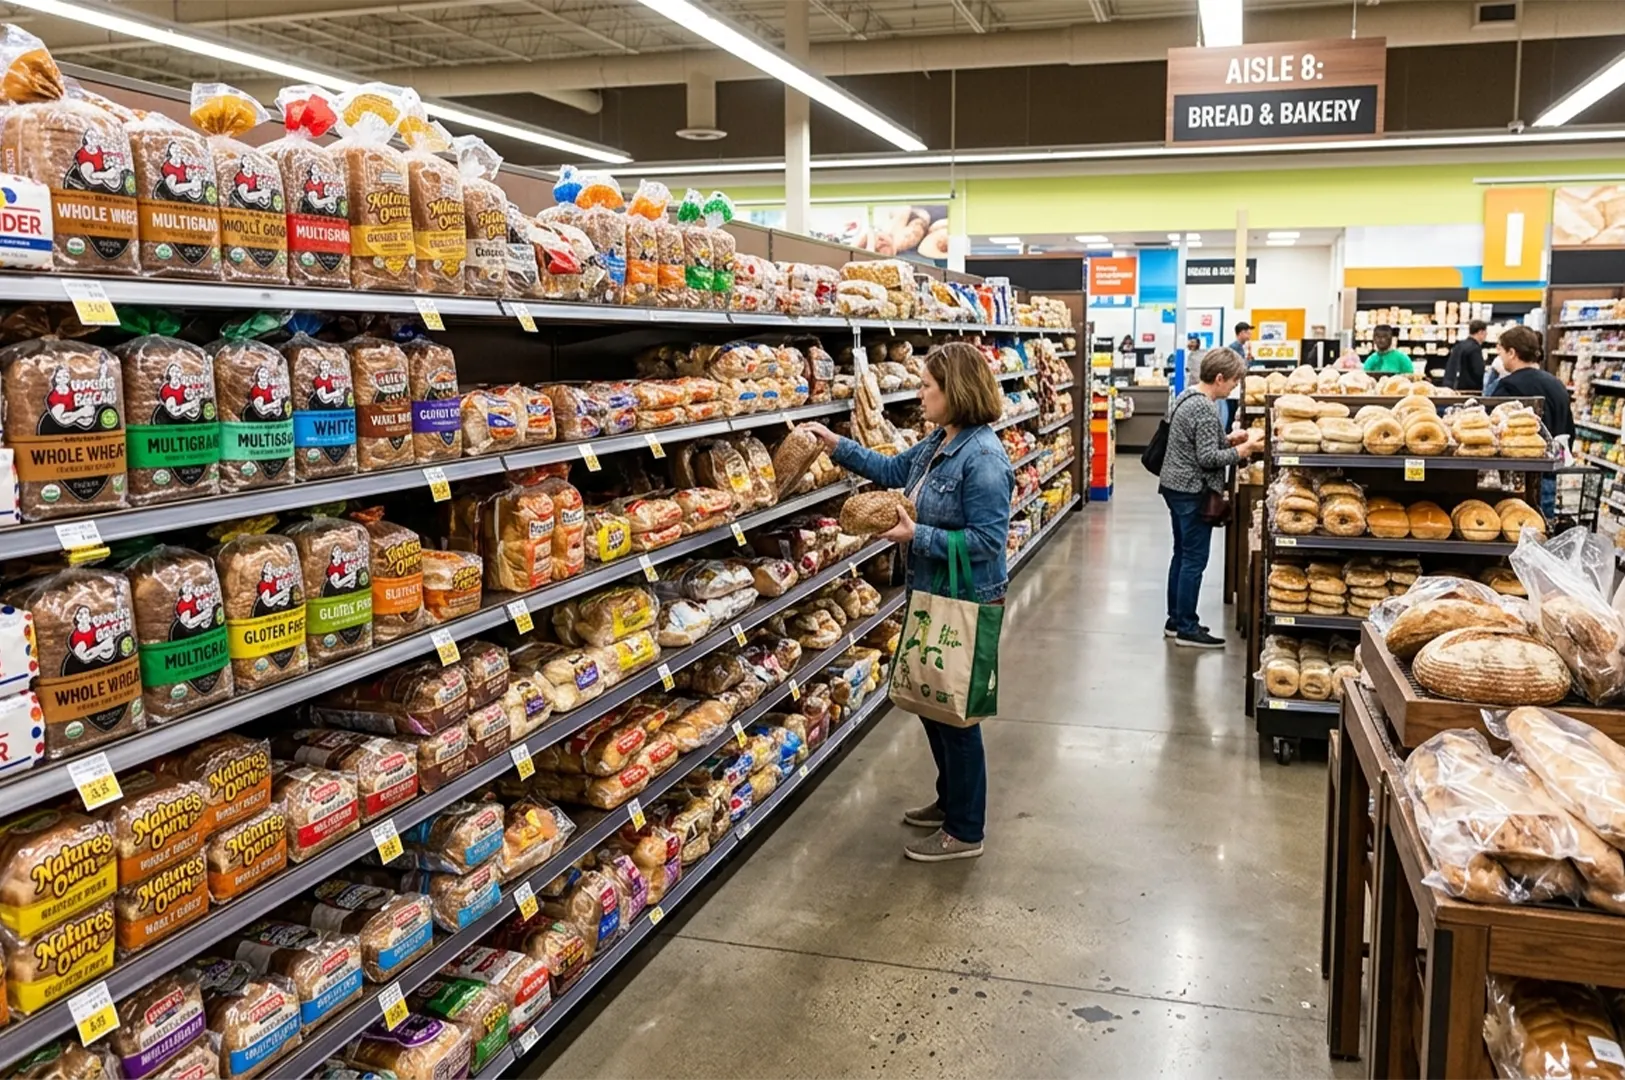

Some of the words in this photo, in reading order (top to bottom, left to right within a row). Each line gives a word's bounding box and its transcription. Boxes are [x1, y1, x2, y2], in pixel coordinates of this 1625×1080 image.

[1225, 55, 1294, 84] AISLE
[1301, 53, 1324, 80] 8:
[1188, 103, 1253, 128] BREAD
[1259, 102, 1274, 125] &
[1280, 98, 1361, 125] BAKERY
[57, 202, 107, 222] WHOLE
[30, 447, 84, 466] WHOLE
[54, 680, 106, 707] WHOLE
